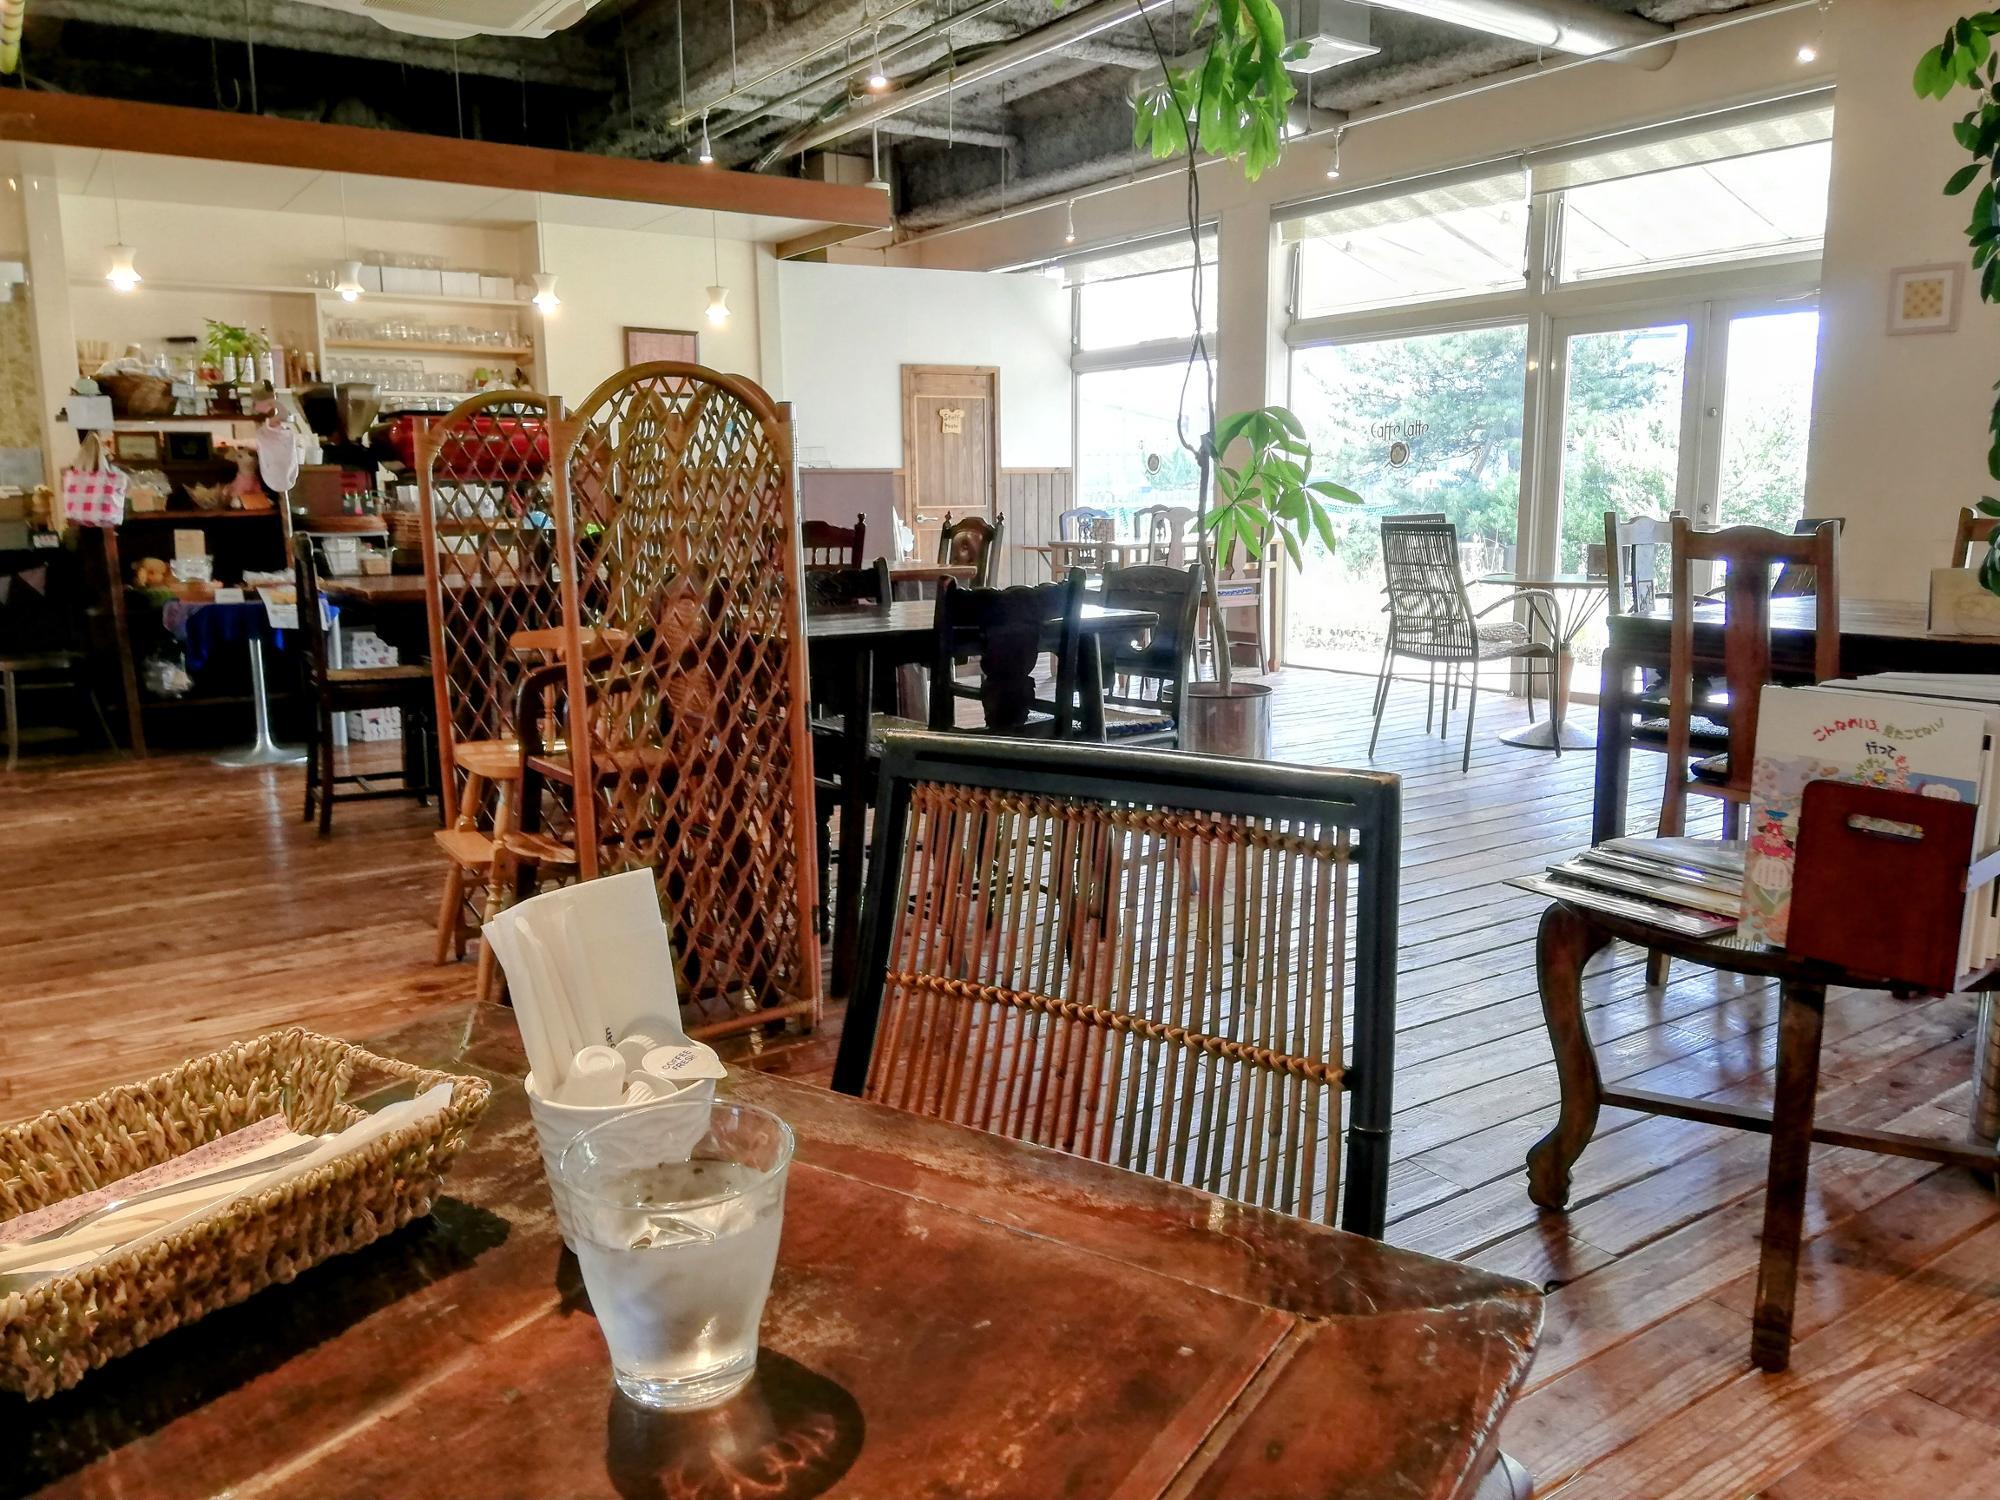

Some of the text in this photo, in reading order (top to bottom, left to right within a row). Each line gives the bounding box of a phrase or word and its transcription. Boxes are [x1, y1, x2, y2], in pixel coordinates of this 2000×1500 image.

[1370, 421, 1401, 441] Caffe
[661, 1049, 692, 1071] COFFEE
[672, 1053, 696, 1071] FRESH
